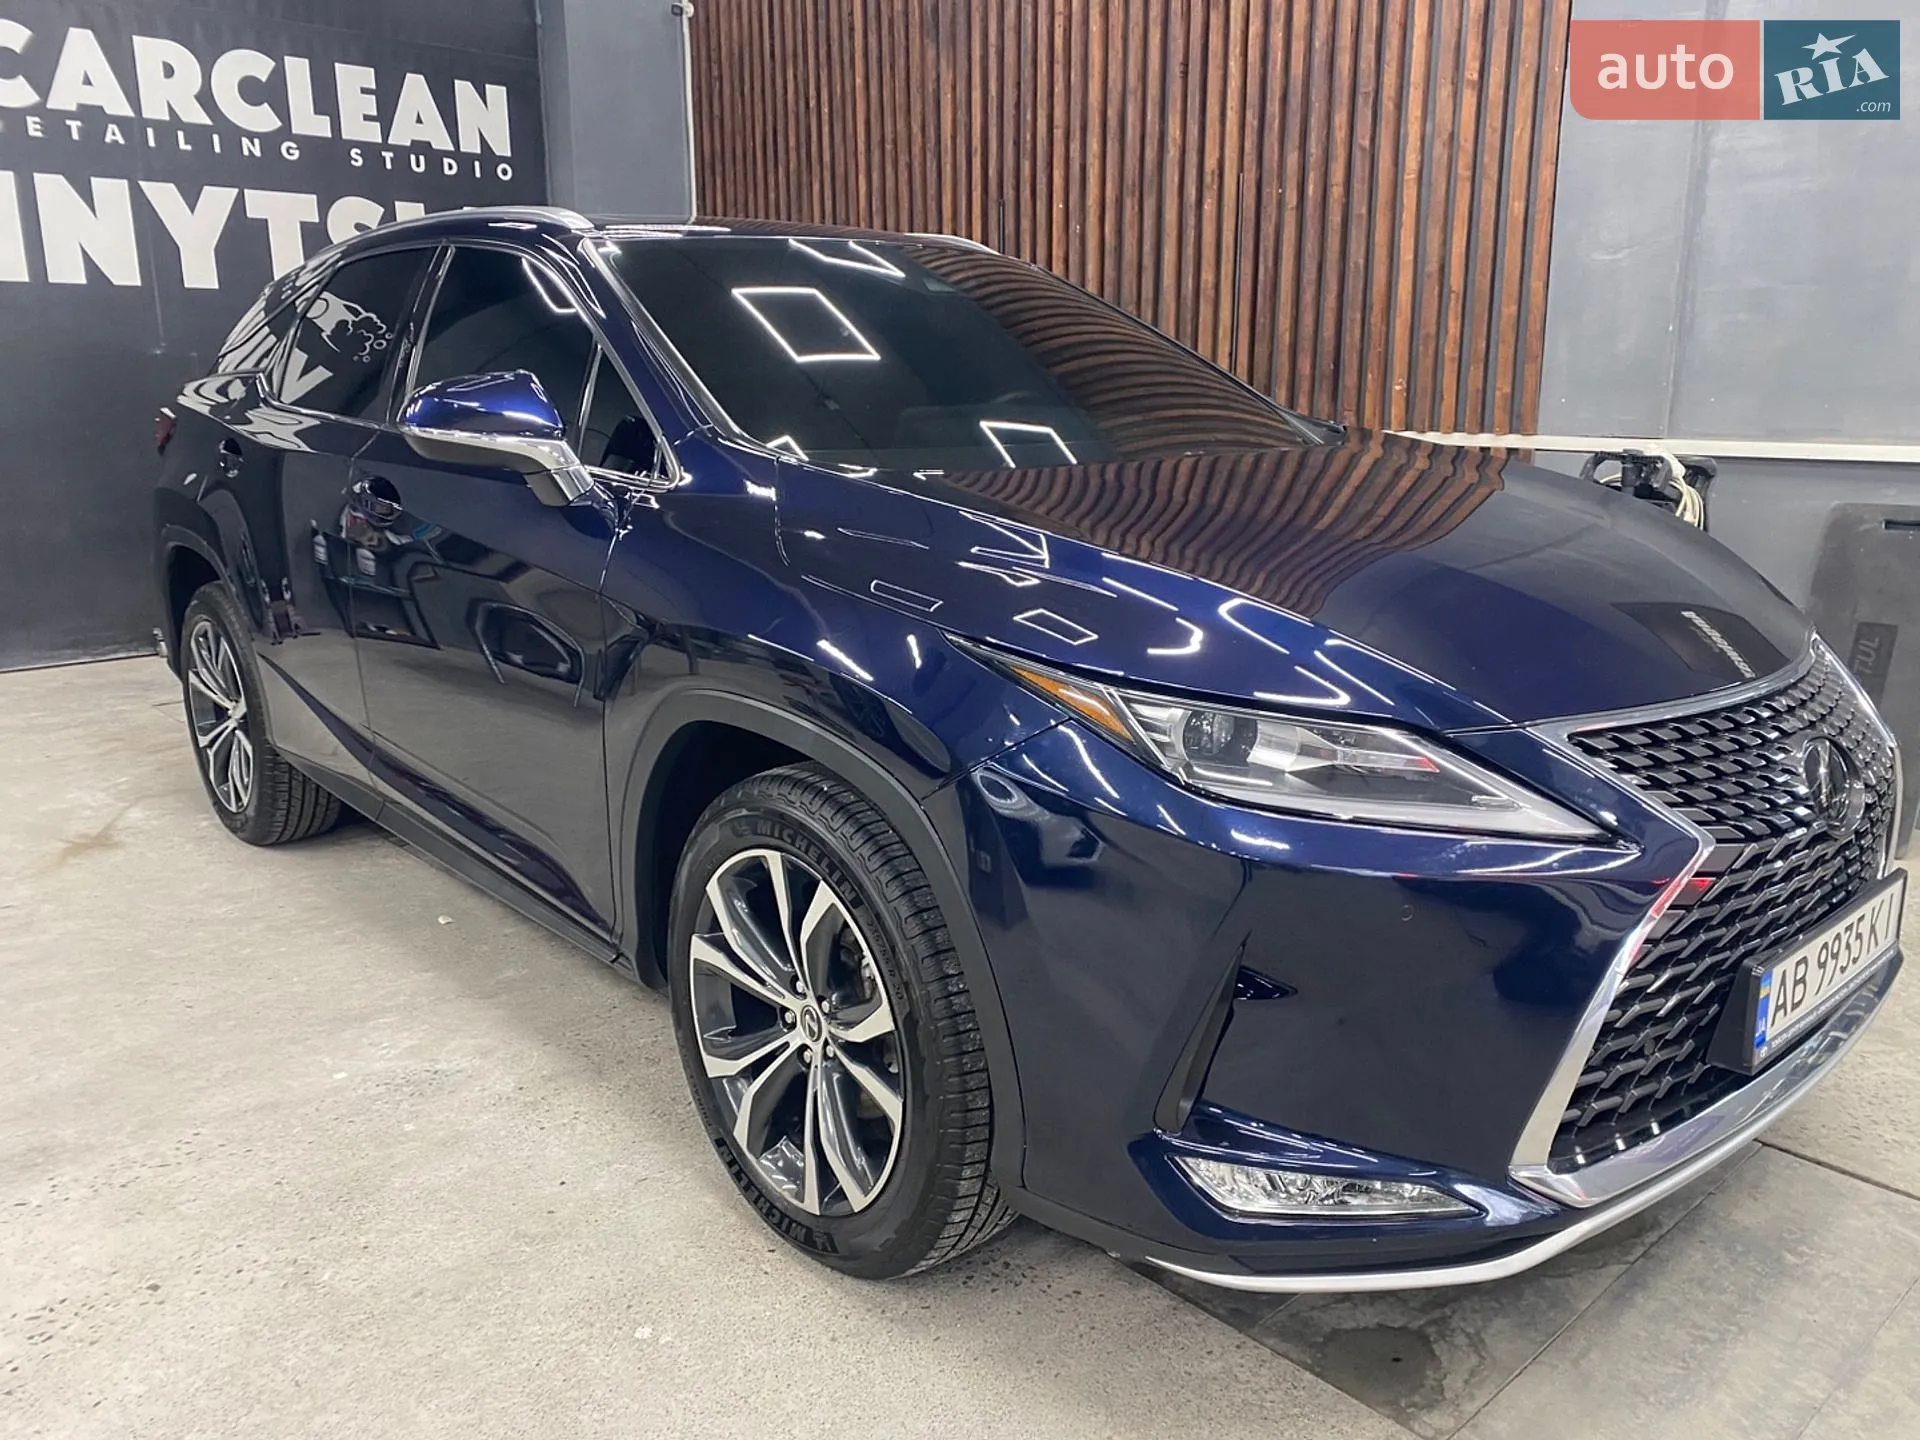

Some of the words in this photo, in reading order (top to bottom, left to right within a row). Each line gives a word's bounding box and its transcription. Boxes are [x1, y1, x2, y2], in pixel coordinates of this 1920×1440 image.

[0, 18, 511, 157] CARCLEAN
[0, 115, 300, 161] ETAILING
[350, 148, 514, 181] STUDIO
[757, 819, 857, 902] MICHELIN
[1770, 955, 1809, 1028] AB
[1815, 914, 1866, 997] 9935
[1867, 893, 1894, 954] KI
